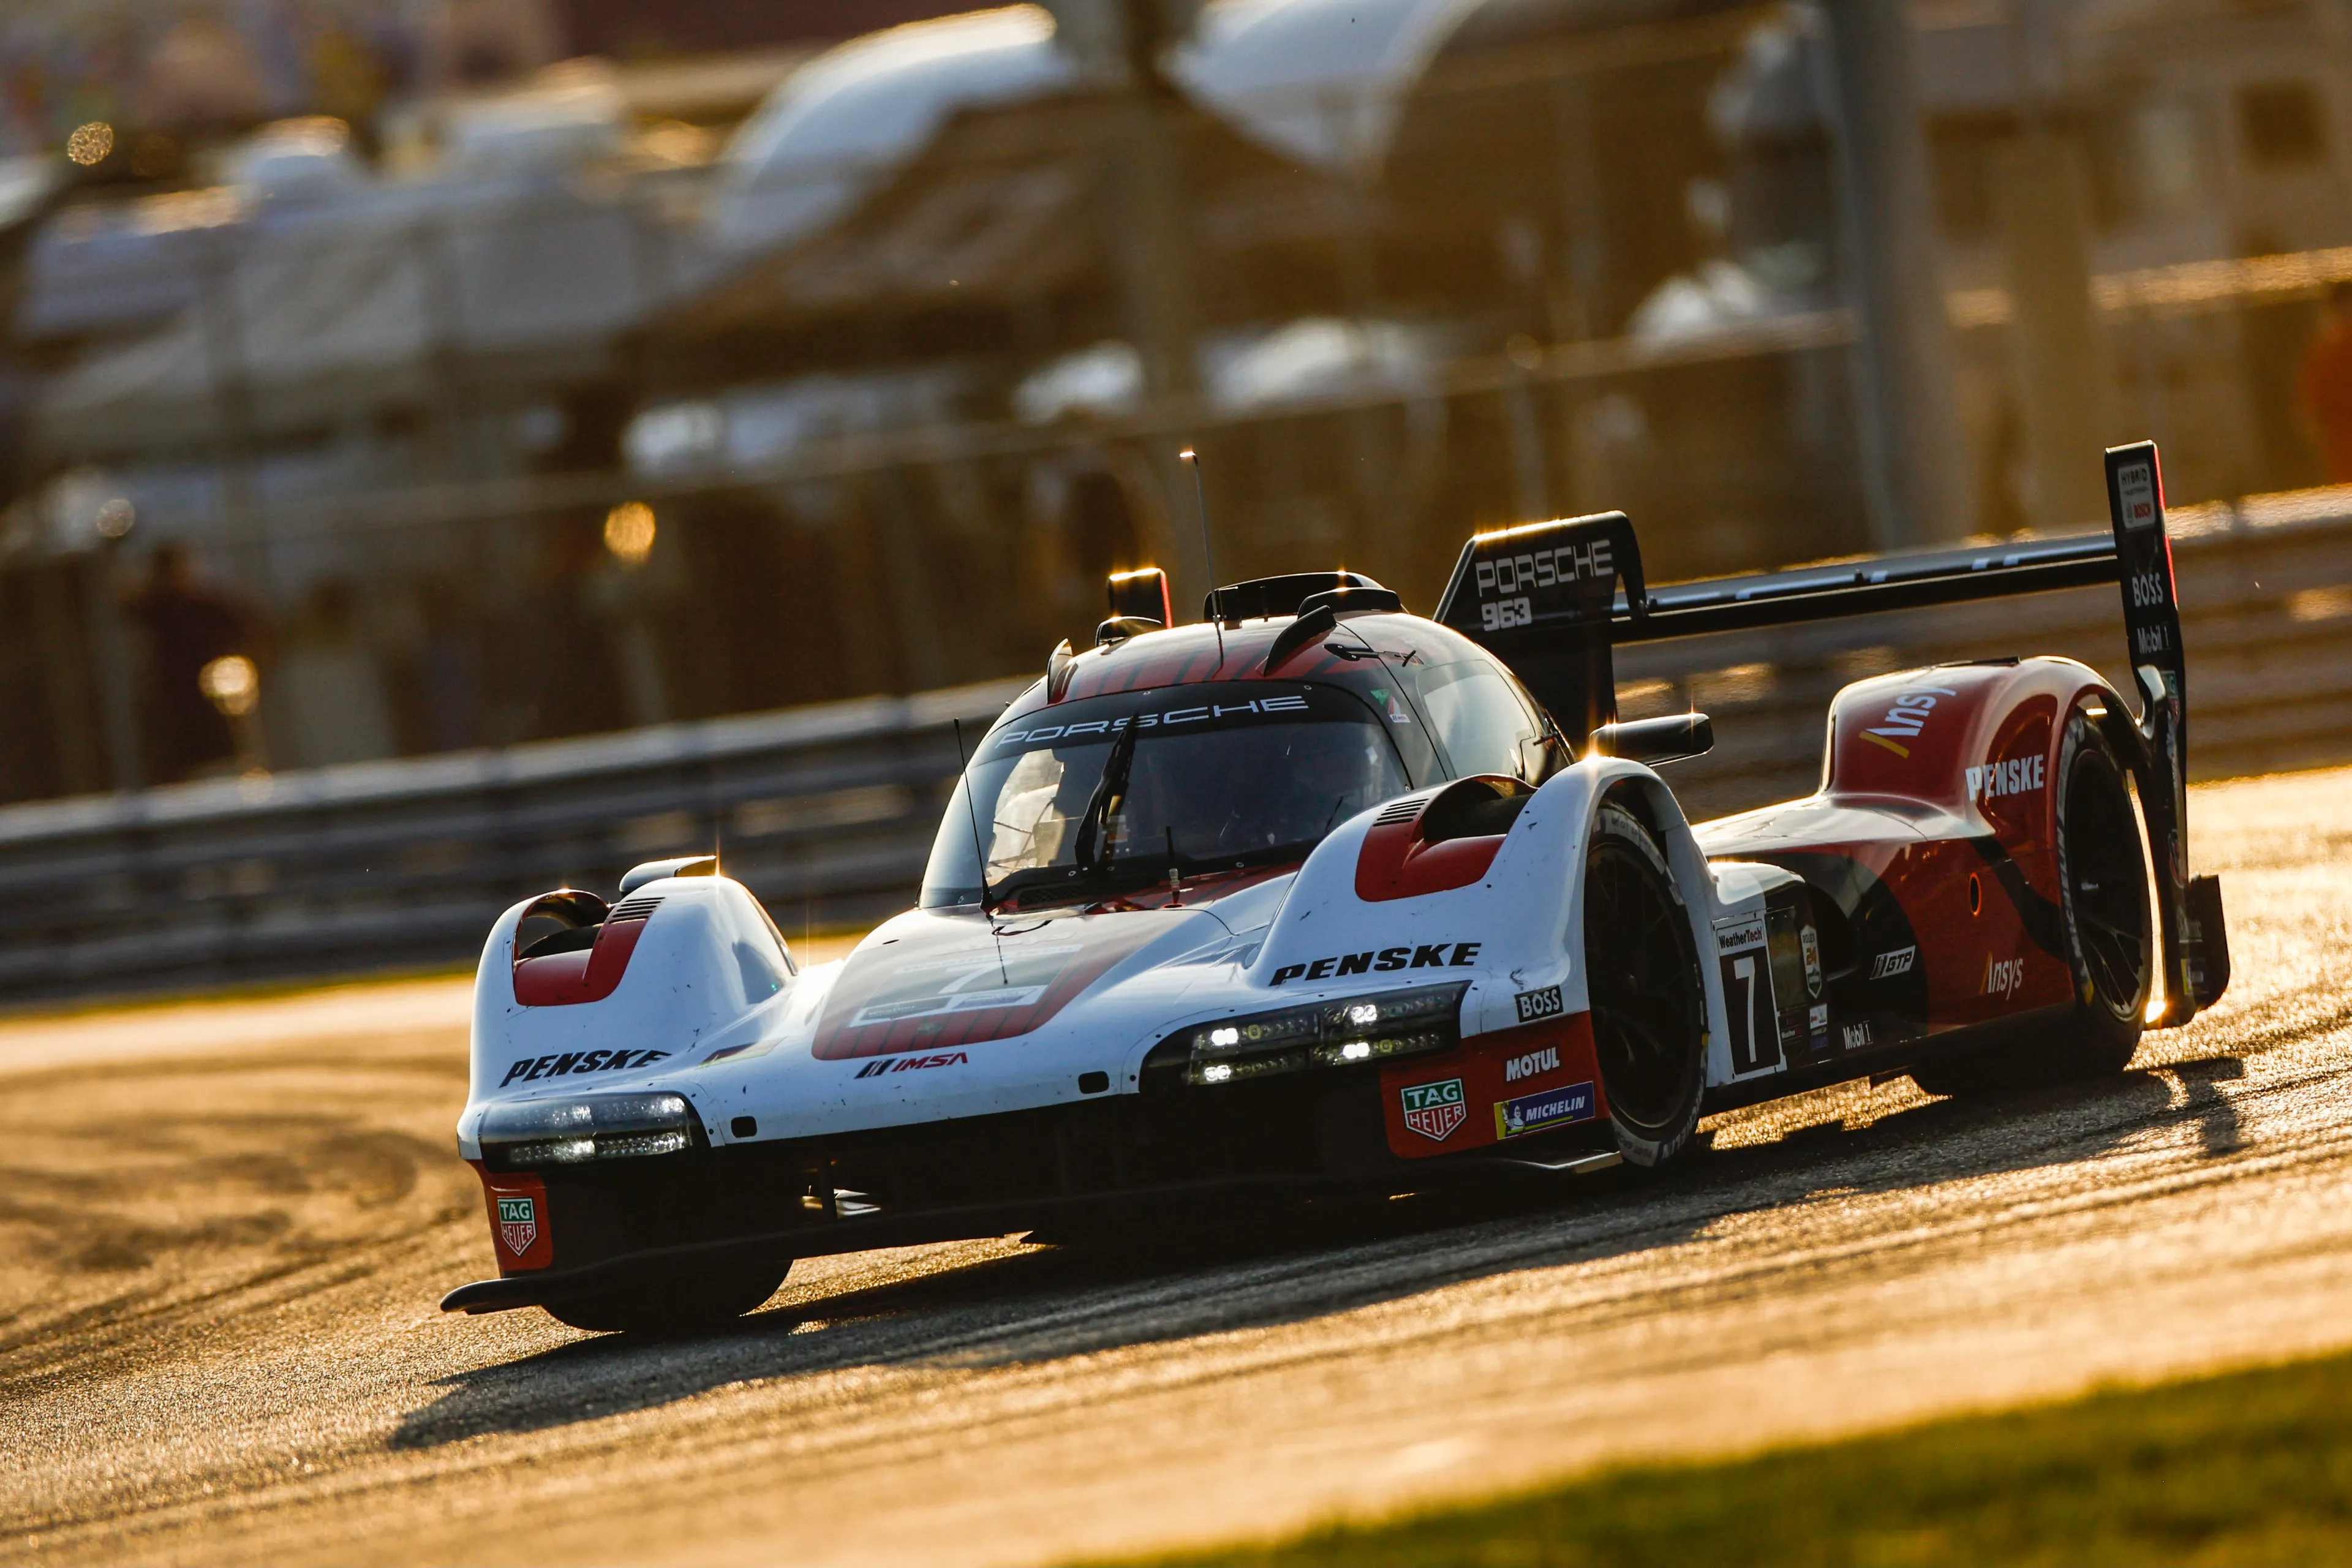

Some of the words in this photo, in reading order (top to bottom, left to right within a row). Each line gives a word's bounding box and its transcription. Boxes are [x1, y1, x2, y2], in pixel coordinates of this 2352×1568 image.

[2121, 469, 2147, 485] HYBRID
[1476, 539, 1613, 597] PORSCHE
[2132, 573, 2163, 607] BOSS
[1482, 597, 1532, 631] 963
[2138, 625, 2162, 654] Mobil
[995, 695, 1310, 748] PORSCHE
[1965, 754, 2044, 801] PENSKE
[1719, 925, 1763, 949] WeatherTech
[1268, 943, 1482, 987] PENSKE
[1886, 951, 1912, 972] GTP
[1988, 956, 2023, 1000] Insys
[1520, 989, 1561, 1017] BOSS
[1733, 956, 1757, 1063] 7
[1843, 1023, 1865, 1050] Mobil
[498, 1049, 673, 1088] PENSKE
[891, 1052, 968, 1072] IMSA
[1506, 1047, 1560, 1082] MOTUL
[1408, 1085, 1459, 1107] TAG
[1526, 1095, 1585, 1122] MICHELIN
[1409, 1106, 1463, 1136] HEUER
[500, 1202, 530, 1219] TAG
[502, 1224, 533, 1250] HEUER
